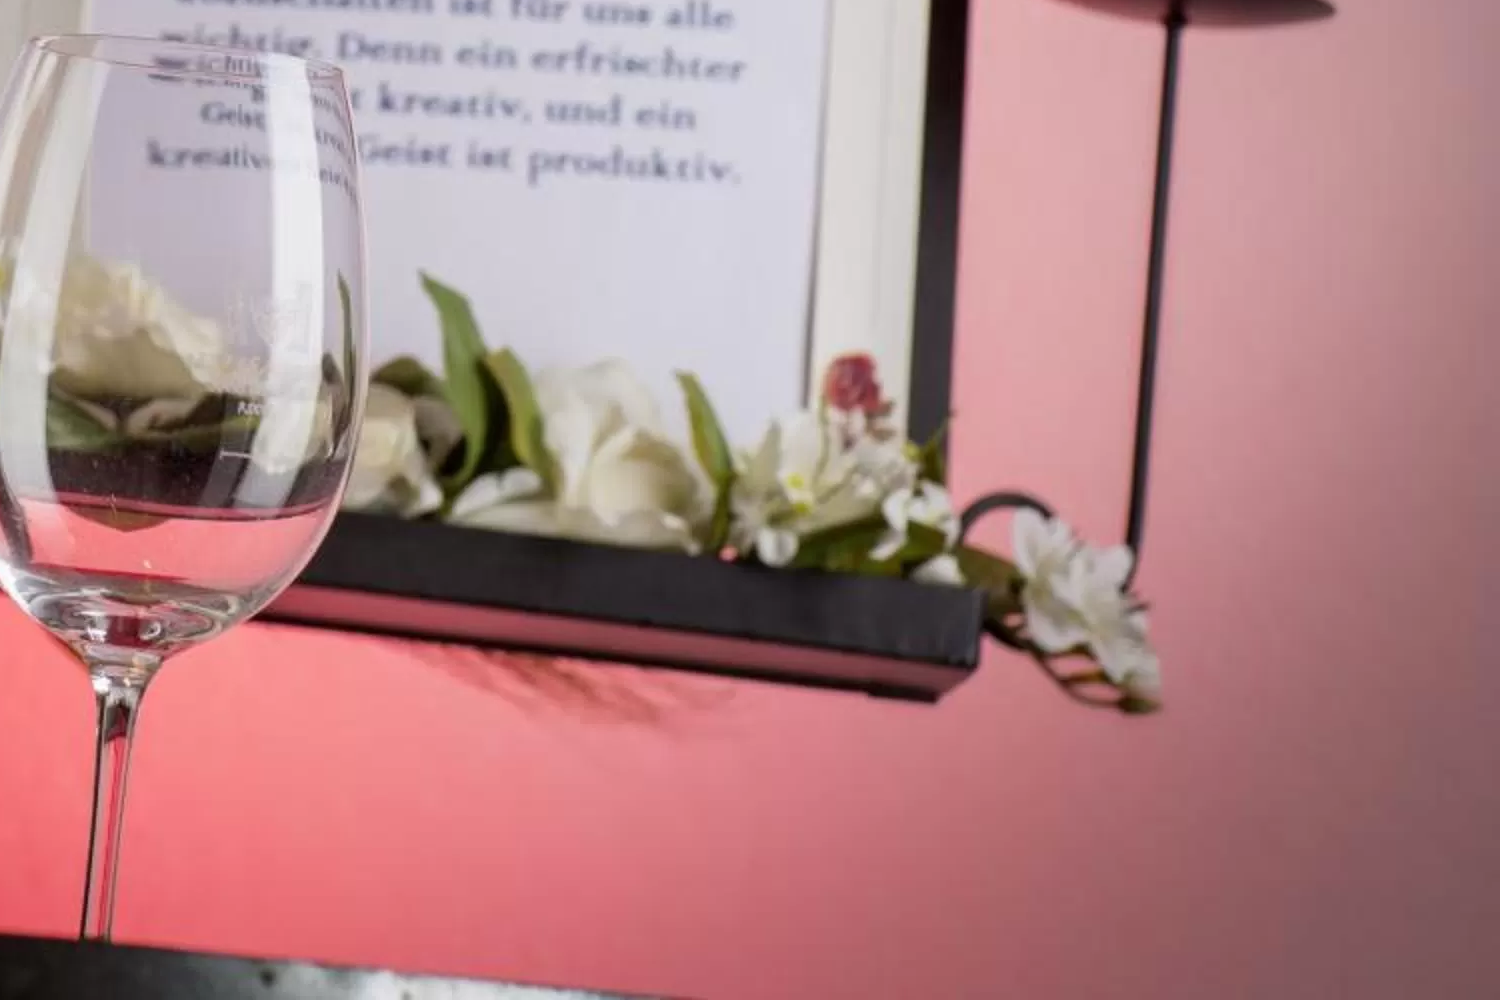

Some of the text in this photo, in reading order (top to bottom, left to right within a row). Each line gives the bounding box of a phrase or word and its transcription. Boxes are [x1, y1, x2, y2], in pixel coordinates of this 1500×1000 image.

[583, 1, 653, 28] uns
[335, 31, 442, 64] Denn
[455, 40, 519, 69] ein
[530, 43, 747, 82] erfrischter
[543, 94, 623, 127] und
[635, 101, 698, 130] ein
[466, 139, 512, 171] ist
[528, 144, 743, 187] produktiv.
